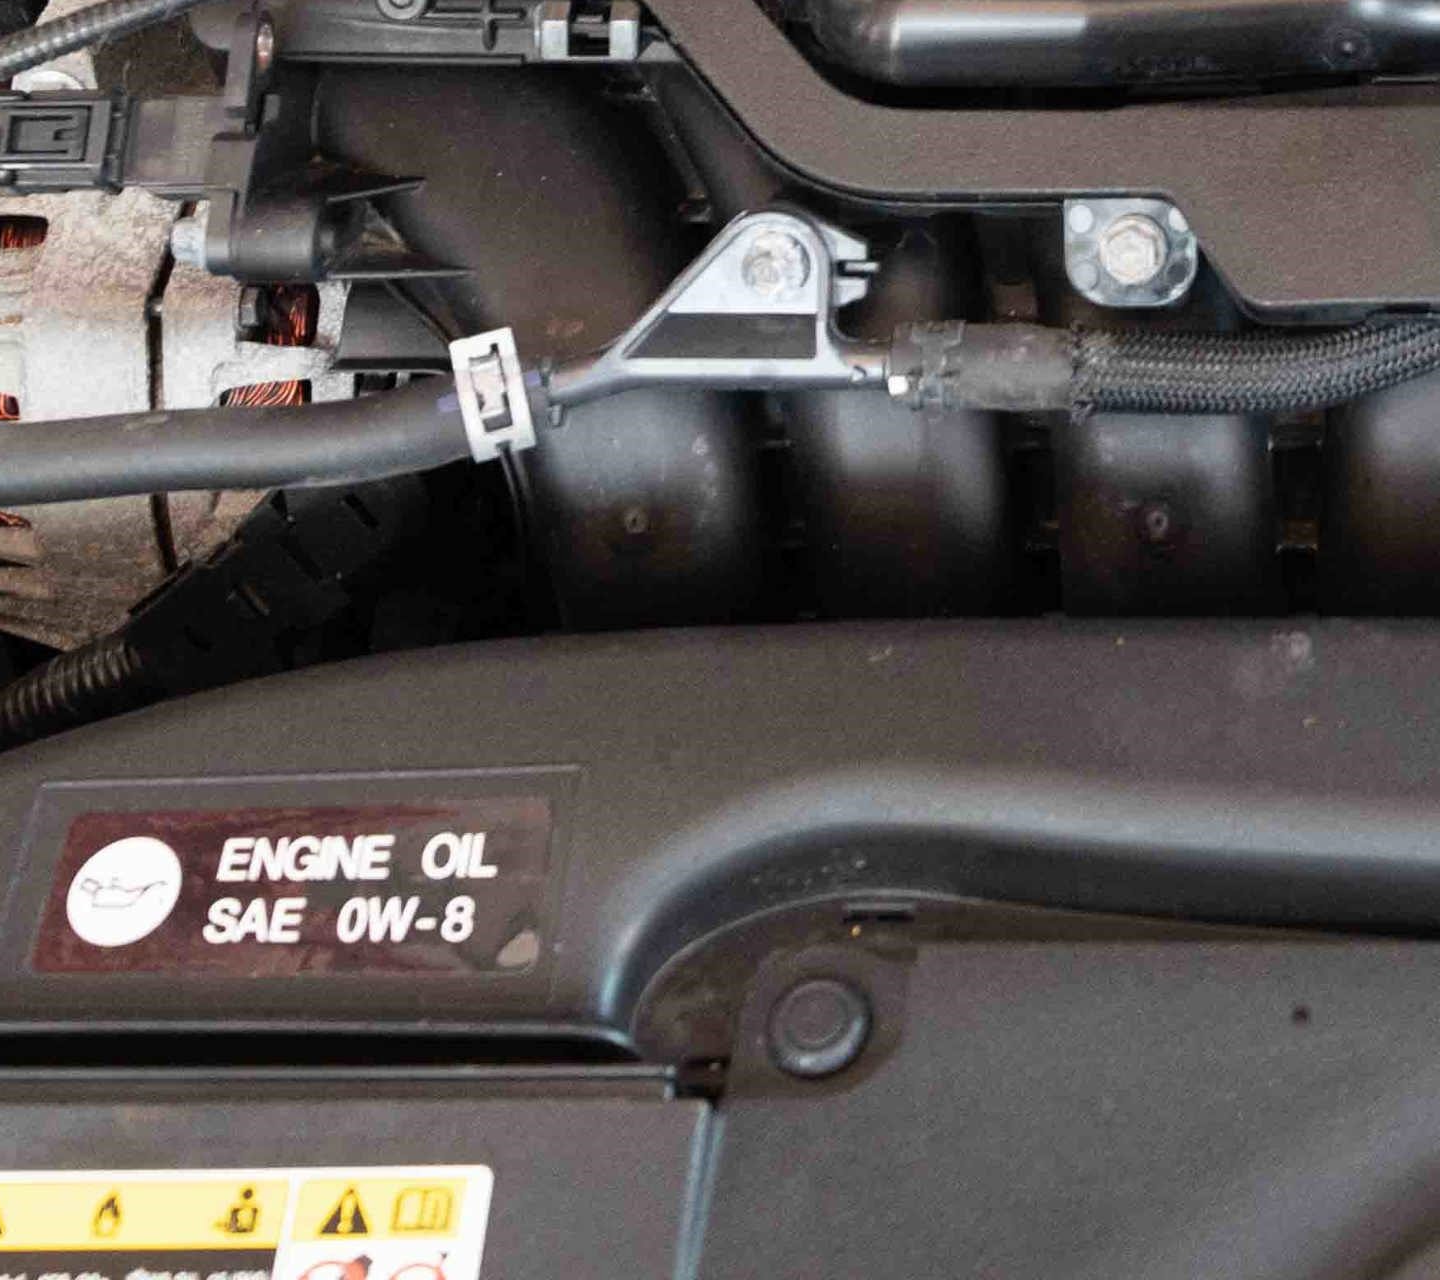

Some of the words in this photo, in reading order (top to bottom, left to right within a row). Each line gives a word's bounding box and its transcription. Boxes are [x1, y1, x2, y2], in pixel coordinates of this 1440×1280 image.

[216, 834, 394, 882] ENGINE
[421, 832, 498, 880] OIL
[202, 896, 308, 945] SAE
[336, 895, 476, 944] 0W-8
